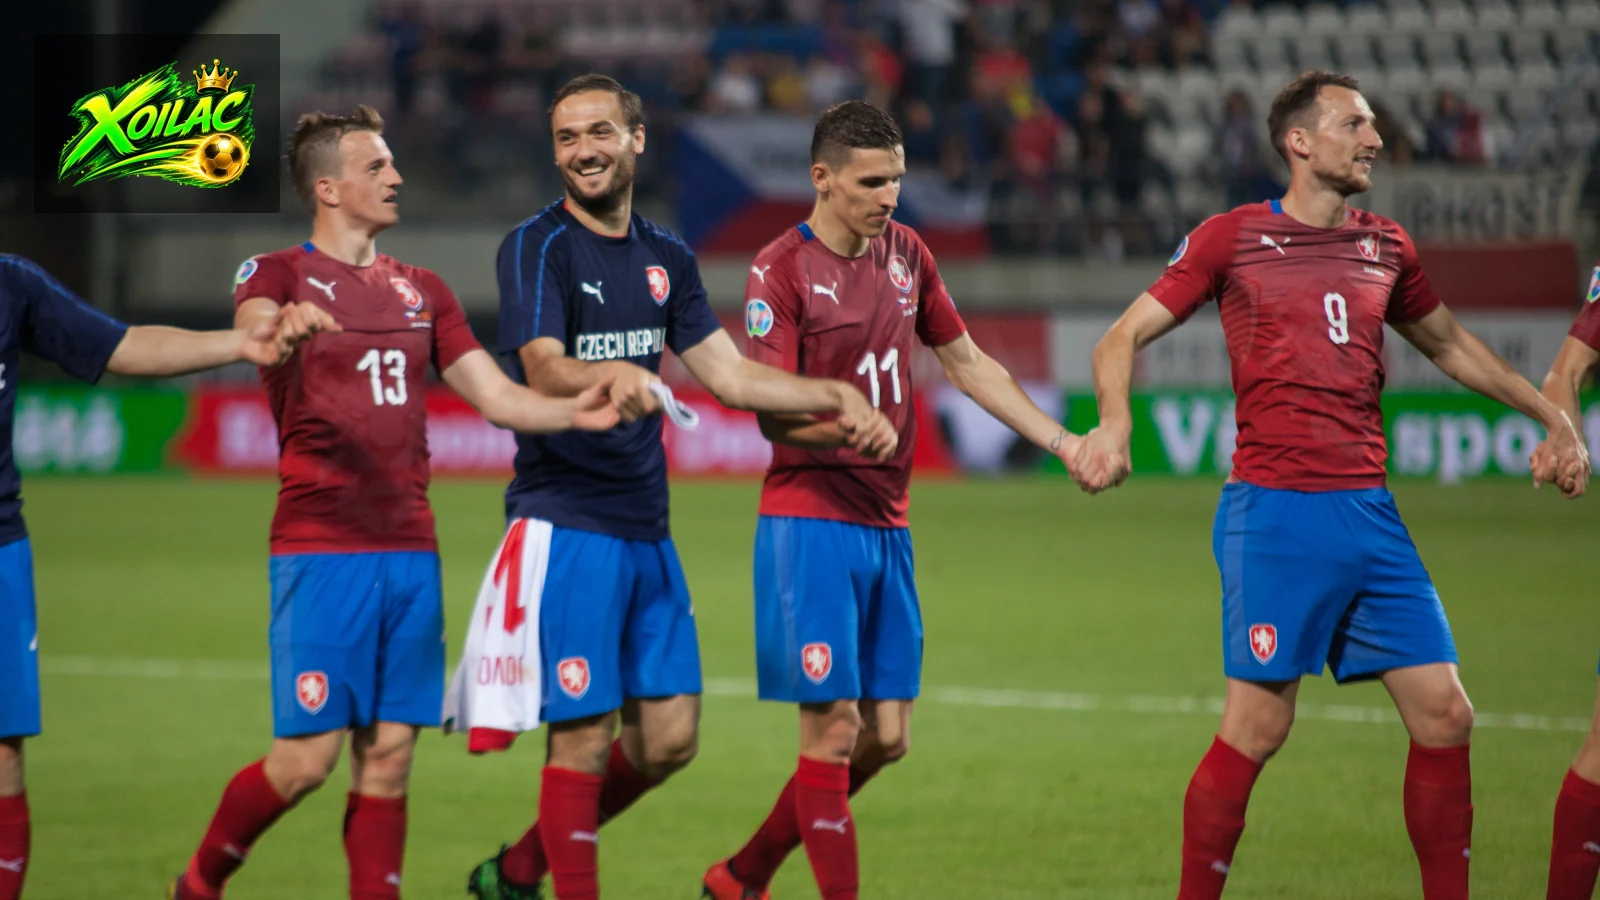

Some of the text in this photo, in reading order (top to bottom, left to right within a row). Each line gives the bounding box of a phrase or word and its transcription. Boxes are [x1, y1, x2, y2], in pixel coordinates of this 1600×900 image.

[1323, 292, 1350, 344] 9
[576, 332, 625, 360] CZECH
[356, 348, 408, 405] 13
[857, 347, 902, 408] 11
